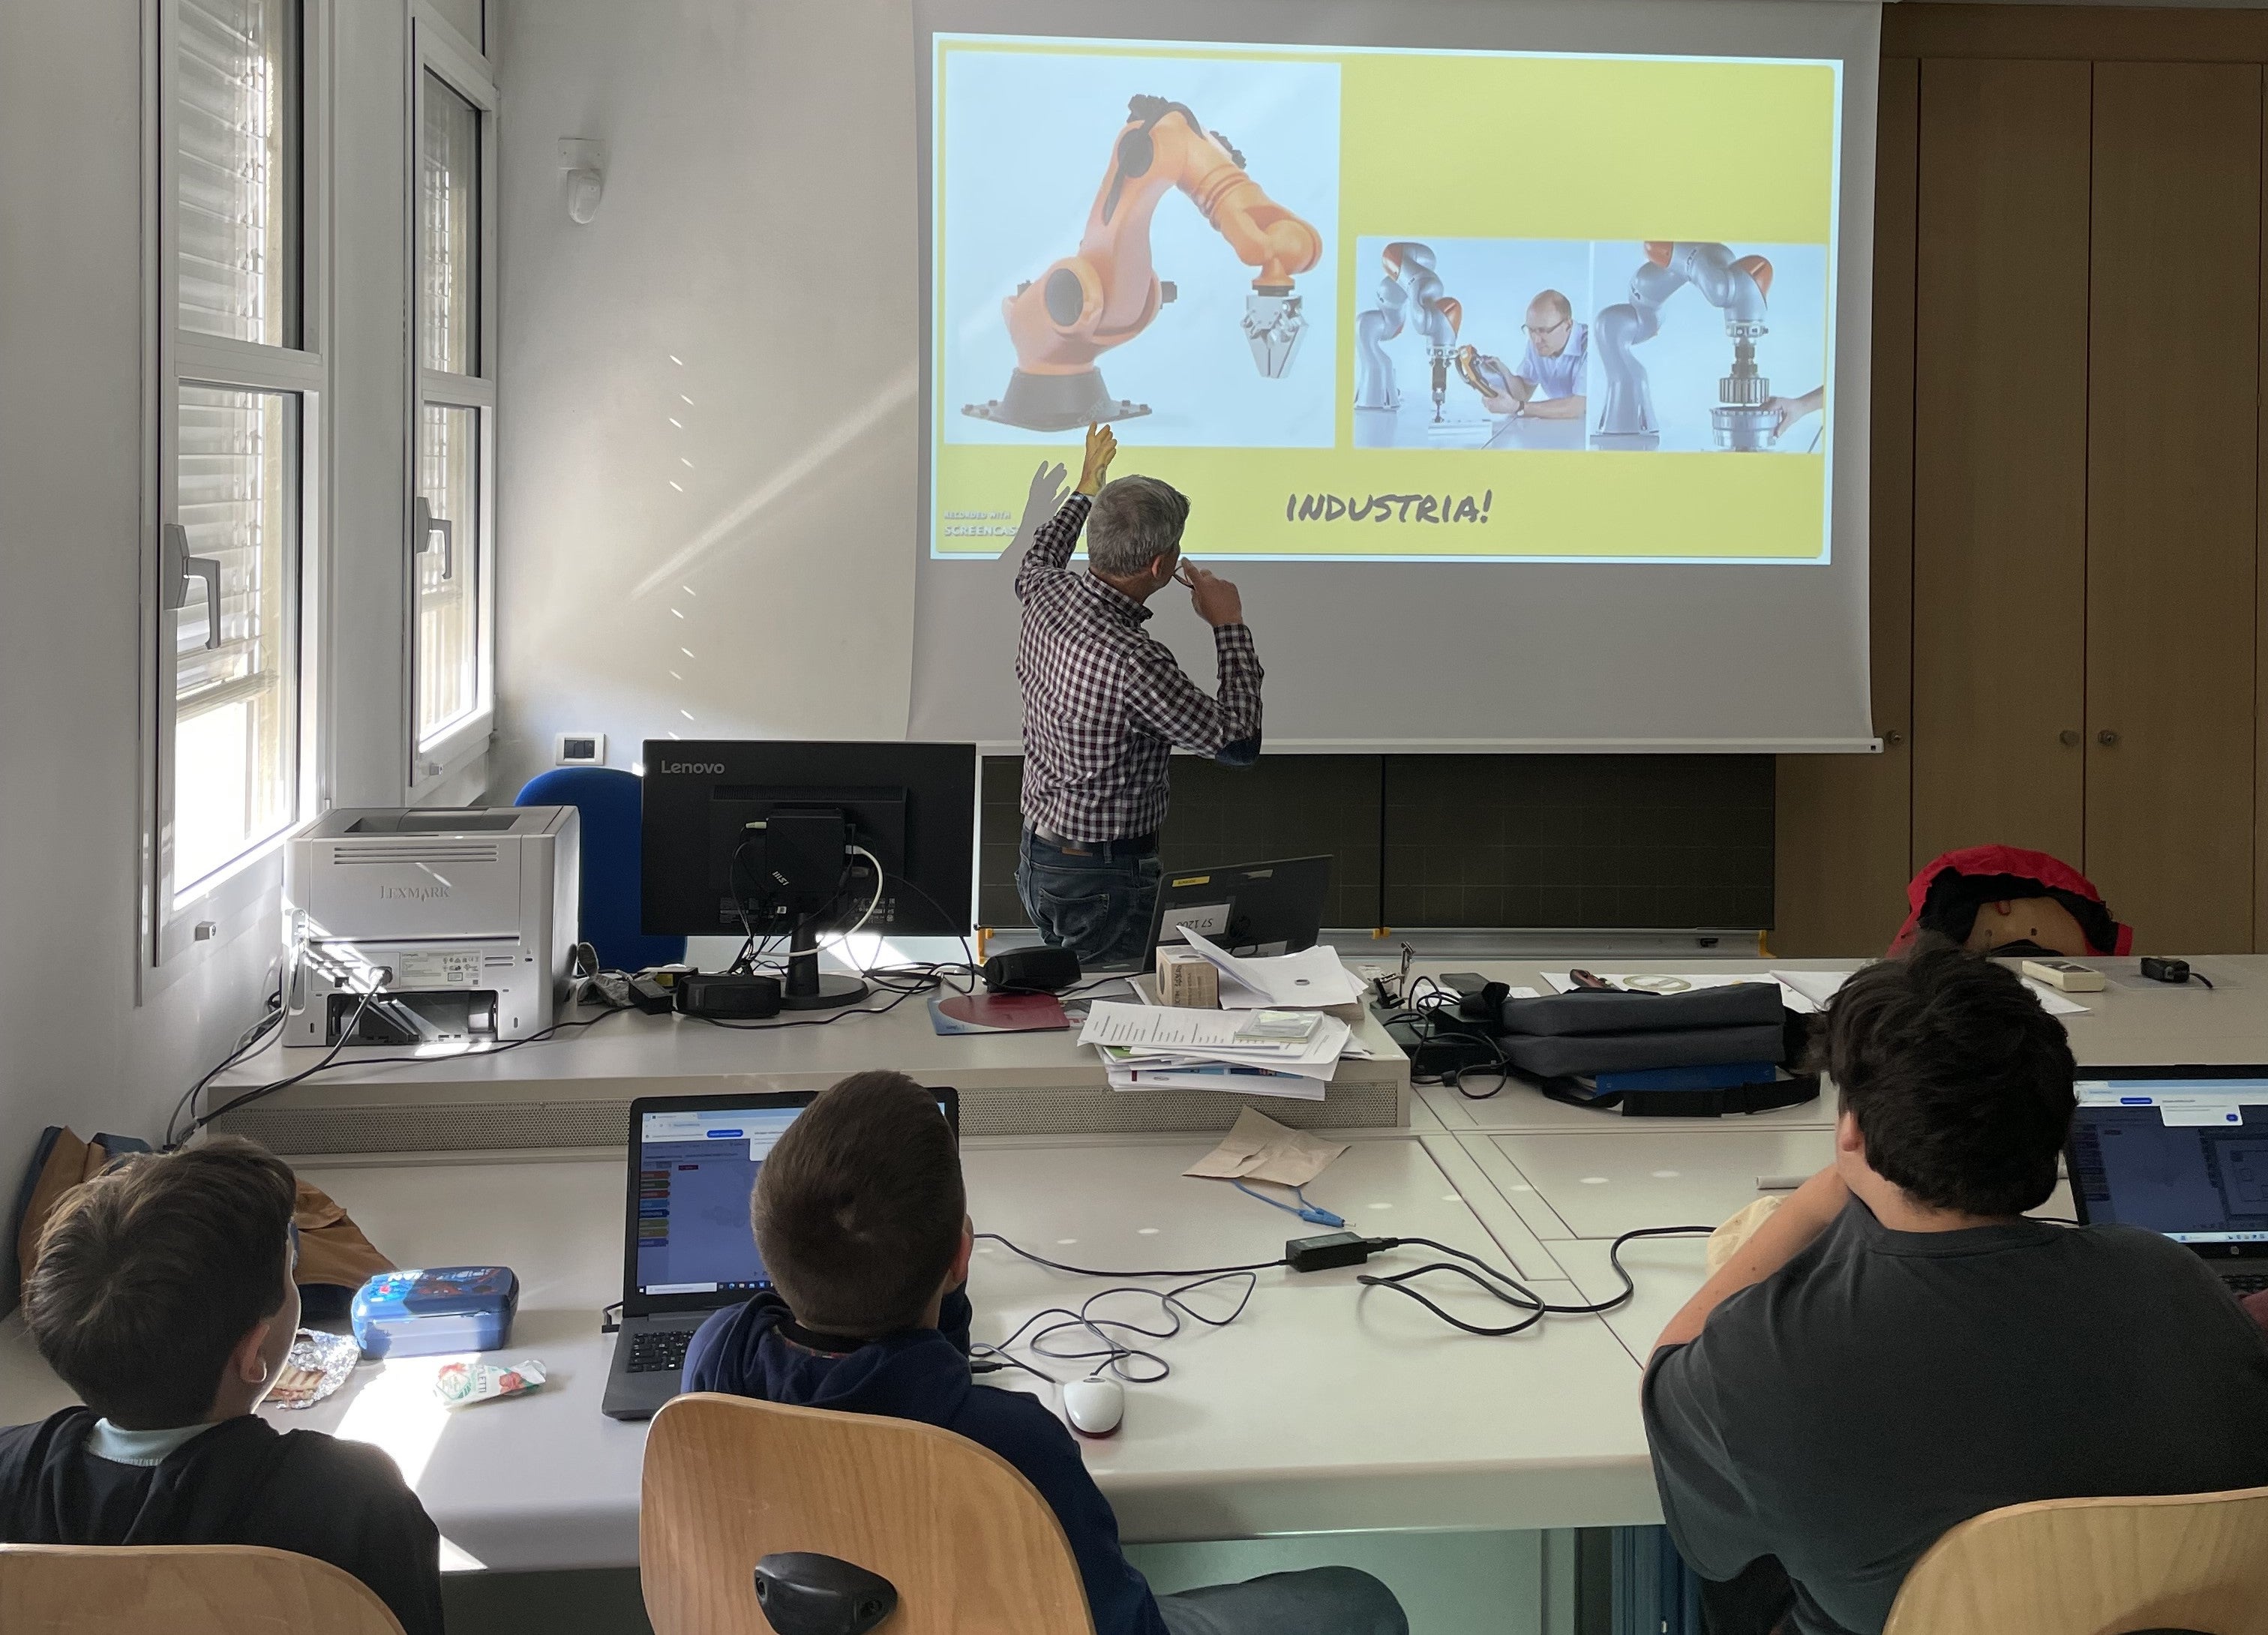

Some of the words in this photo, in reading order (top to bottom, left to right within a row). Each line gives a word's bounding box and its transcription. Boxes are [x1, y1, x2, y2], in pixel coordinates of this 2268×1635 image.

[1286, 488, 1492, 524] INDUSTRIA!
[944, 526, 1019, 537] SCREENCAS
[661, 760, 725, 775] Lenovo
[1201, 917, 1214, 928] S7
